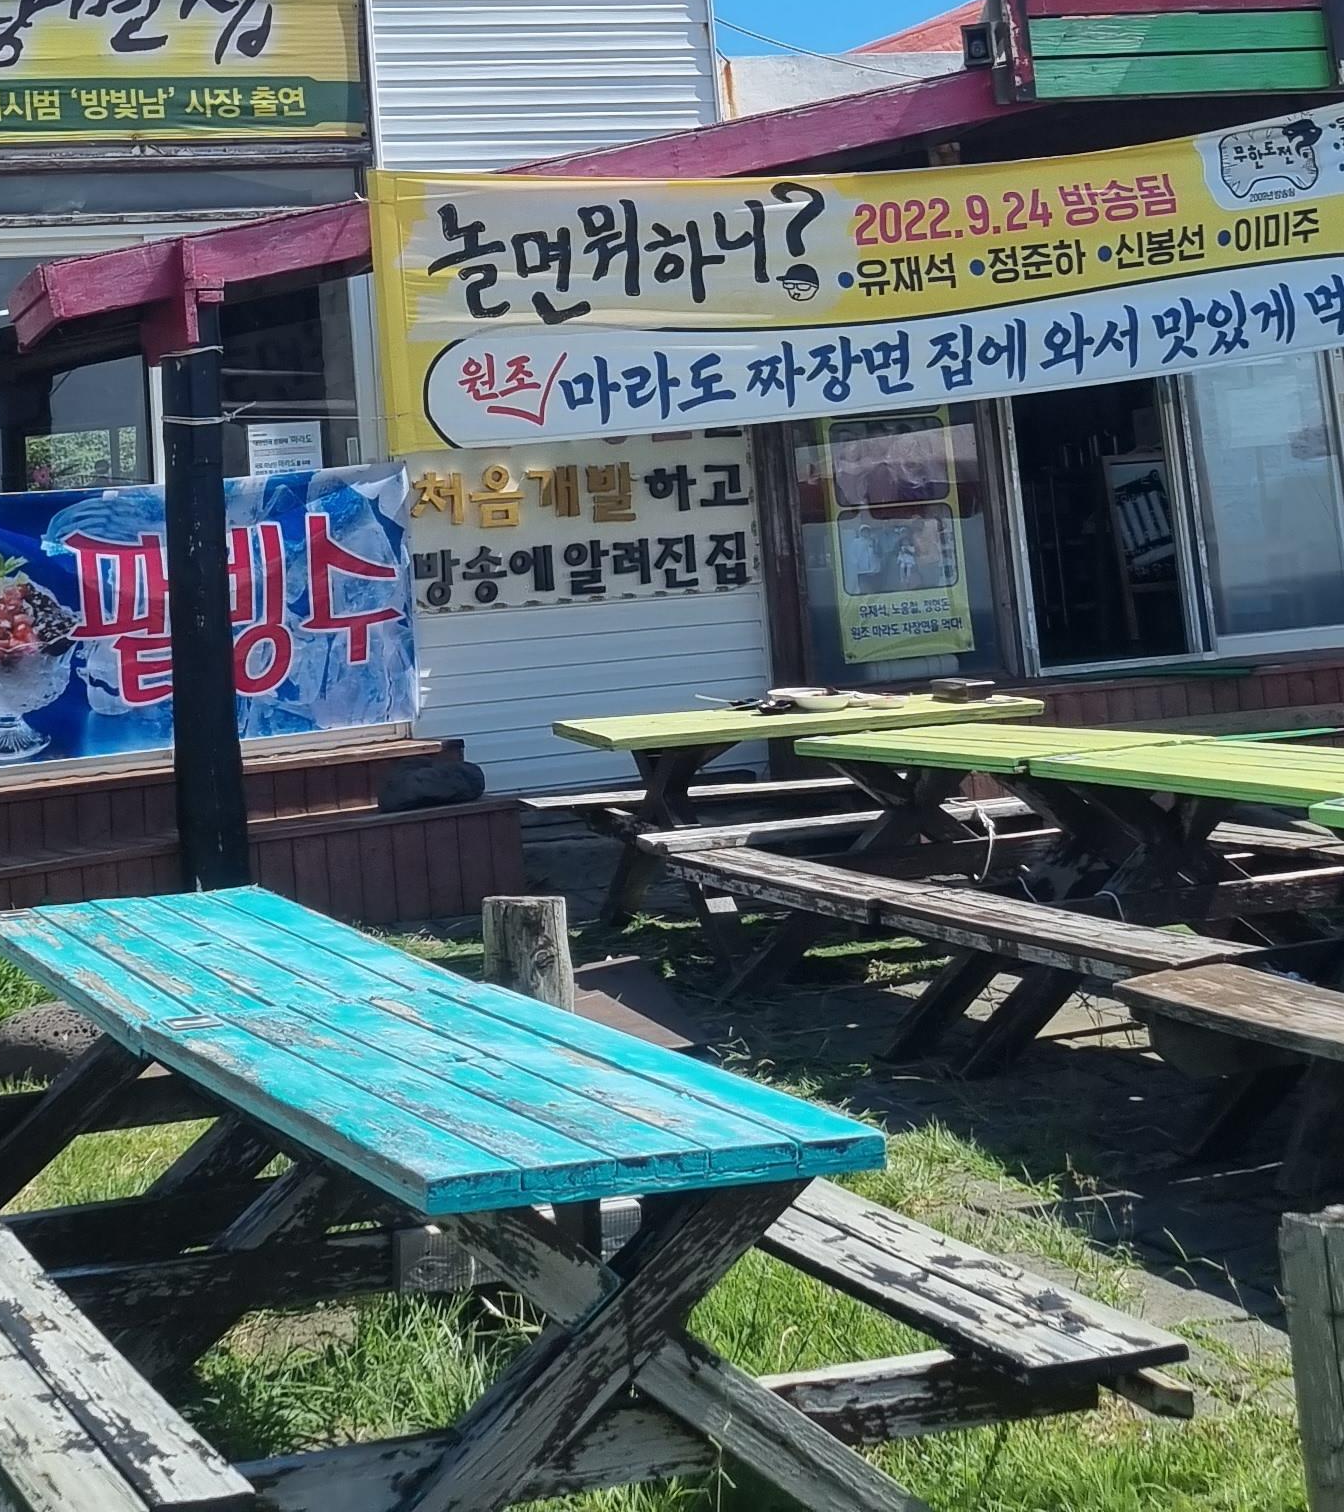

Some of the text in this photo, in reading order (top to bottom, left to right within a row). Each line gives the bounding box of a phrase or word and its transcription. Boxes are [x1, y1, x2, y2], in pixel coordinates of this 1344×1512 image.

[185, 87, 242, 118] 사장
[249, 86, 306, 117] 출연
[1234, 141, 1294, 169] 무한도전
[855, 174, 1177, 245] 2022.9.24 방송됨
[856, 208, 1320, 296] 유재석 정준하 신봉선 이미주
[458, 352, 541, 402] 원조
[559, 352, 736, 424] 마라도
[746, 330, 911, 406] 짜장면
[927, 325, 1027, 391] 집에
[1044, 304, 1138, 374] 와서
[1156, 286, 1295, 362] 맛있게
[63, 513, 404, 706] 팥빙수
